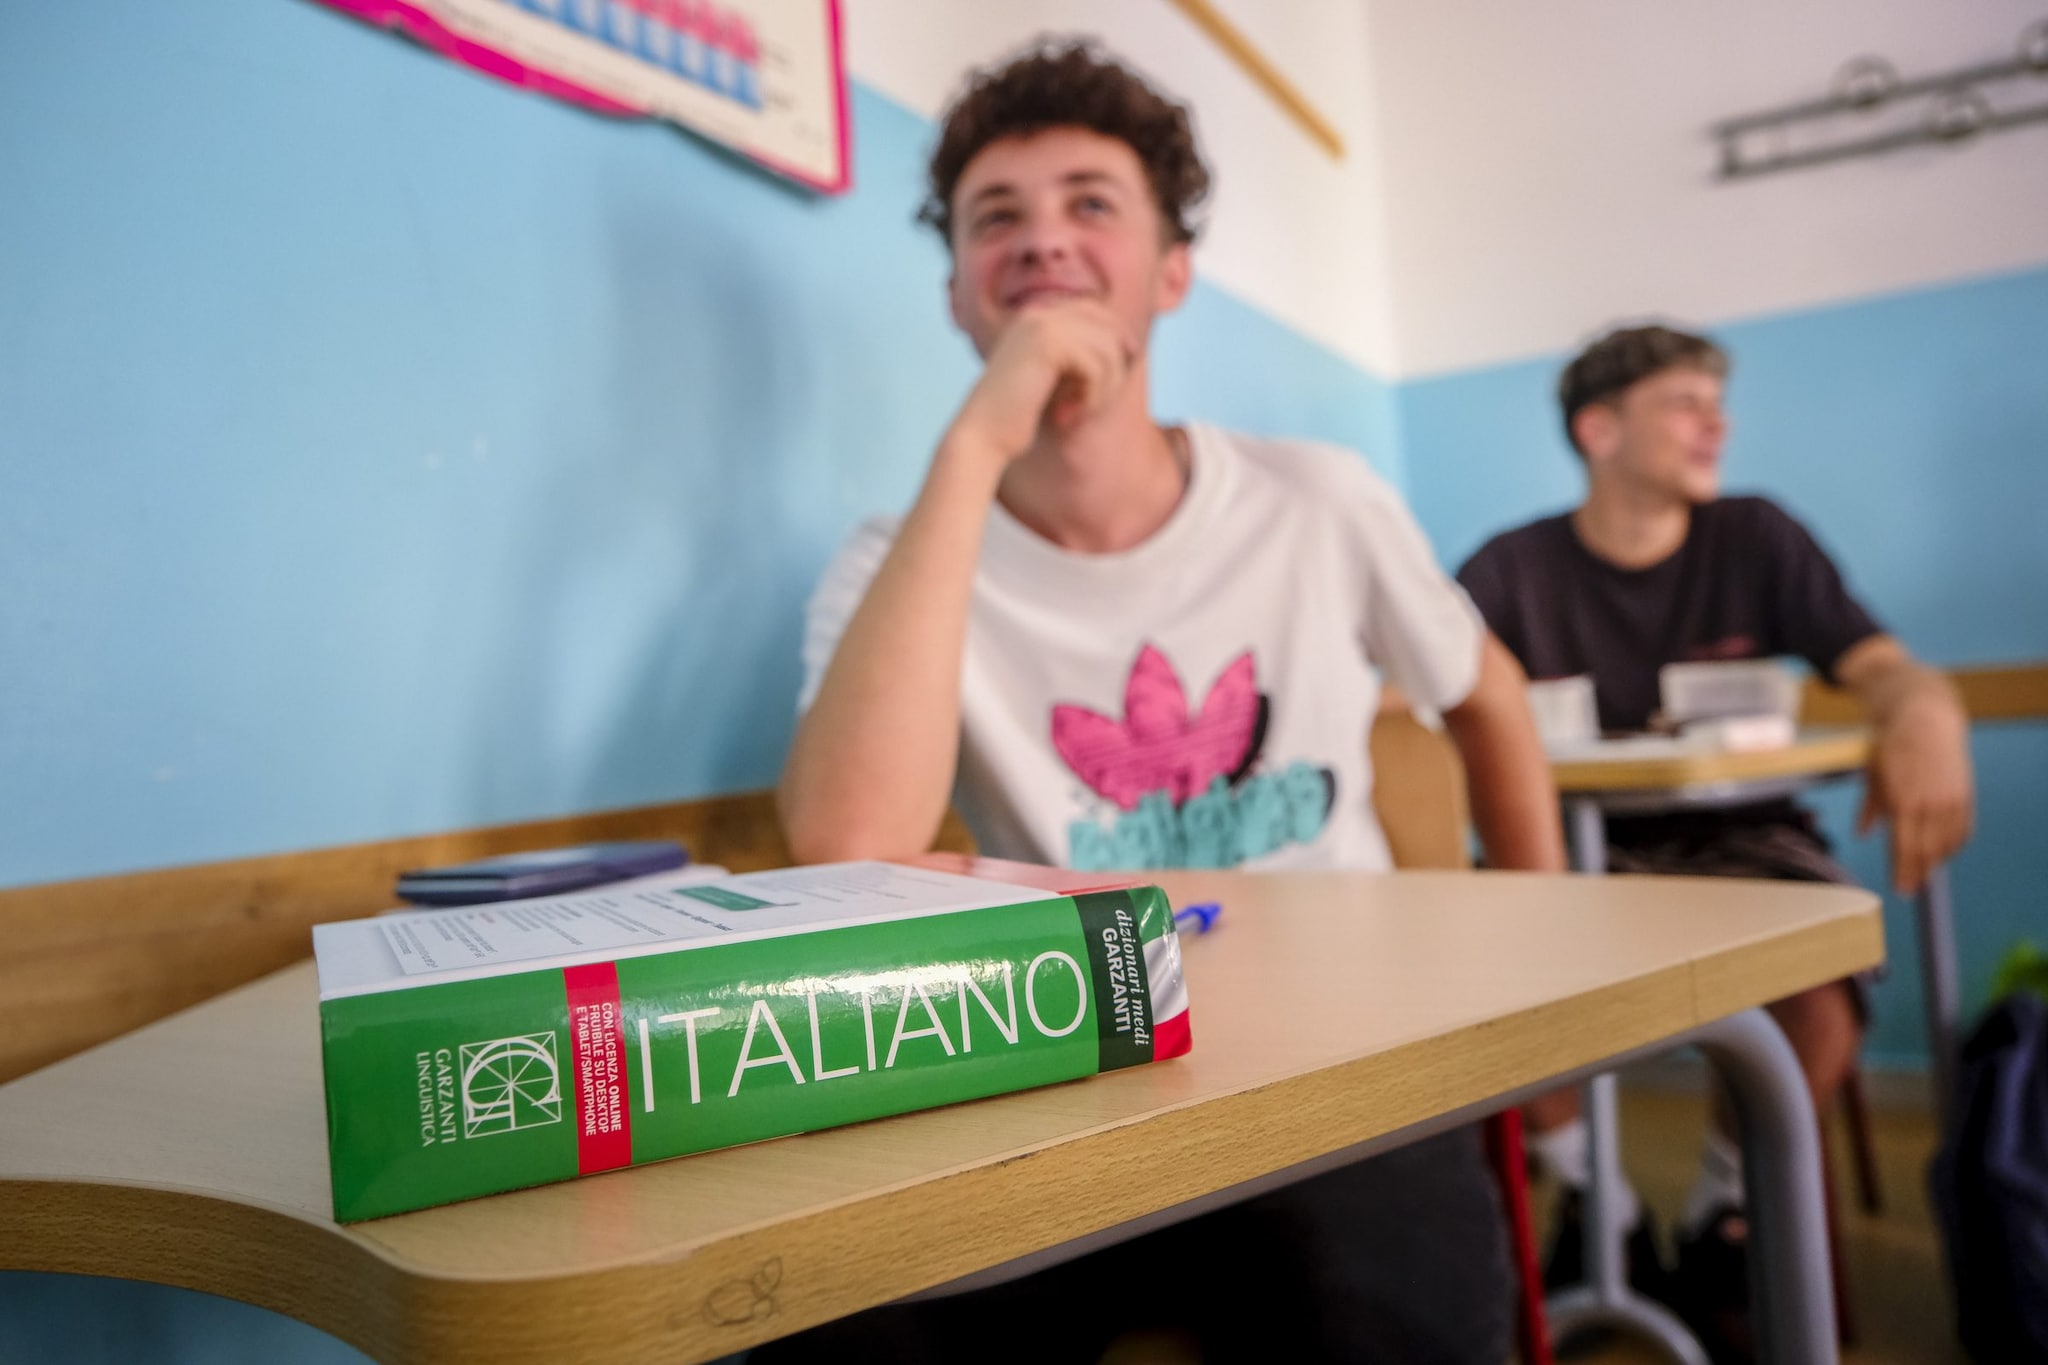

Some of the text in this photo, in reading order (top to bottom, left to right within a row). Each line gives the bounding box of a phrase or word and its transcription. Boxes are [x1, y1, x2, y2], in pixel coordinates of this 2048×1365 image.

[638, 950, 1087, 1113] ITALIANO
[1102, 928, 1131, 1032] GARZANTI
[1115, 909, 1150, 1046] dizionari medi
[416, 1052, 436, 1147] LINGUISTICA
[435, 1048, 457, 1144] GARZANTI
[577, 1015, 596, 1136] TABLET/SMARTPHONE
[589, 1004, 609, 1133] FRUIBILE SU DESKTOP
[601, 1002, 621, 1132] CON LICENZA ONLINE
